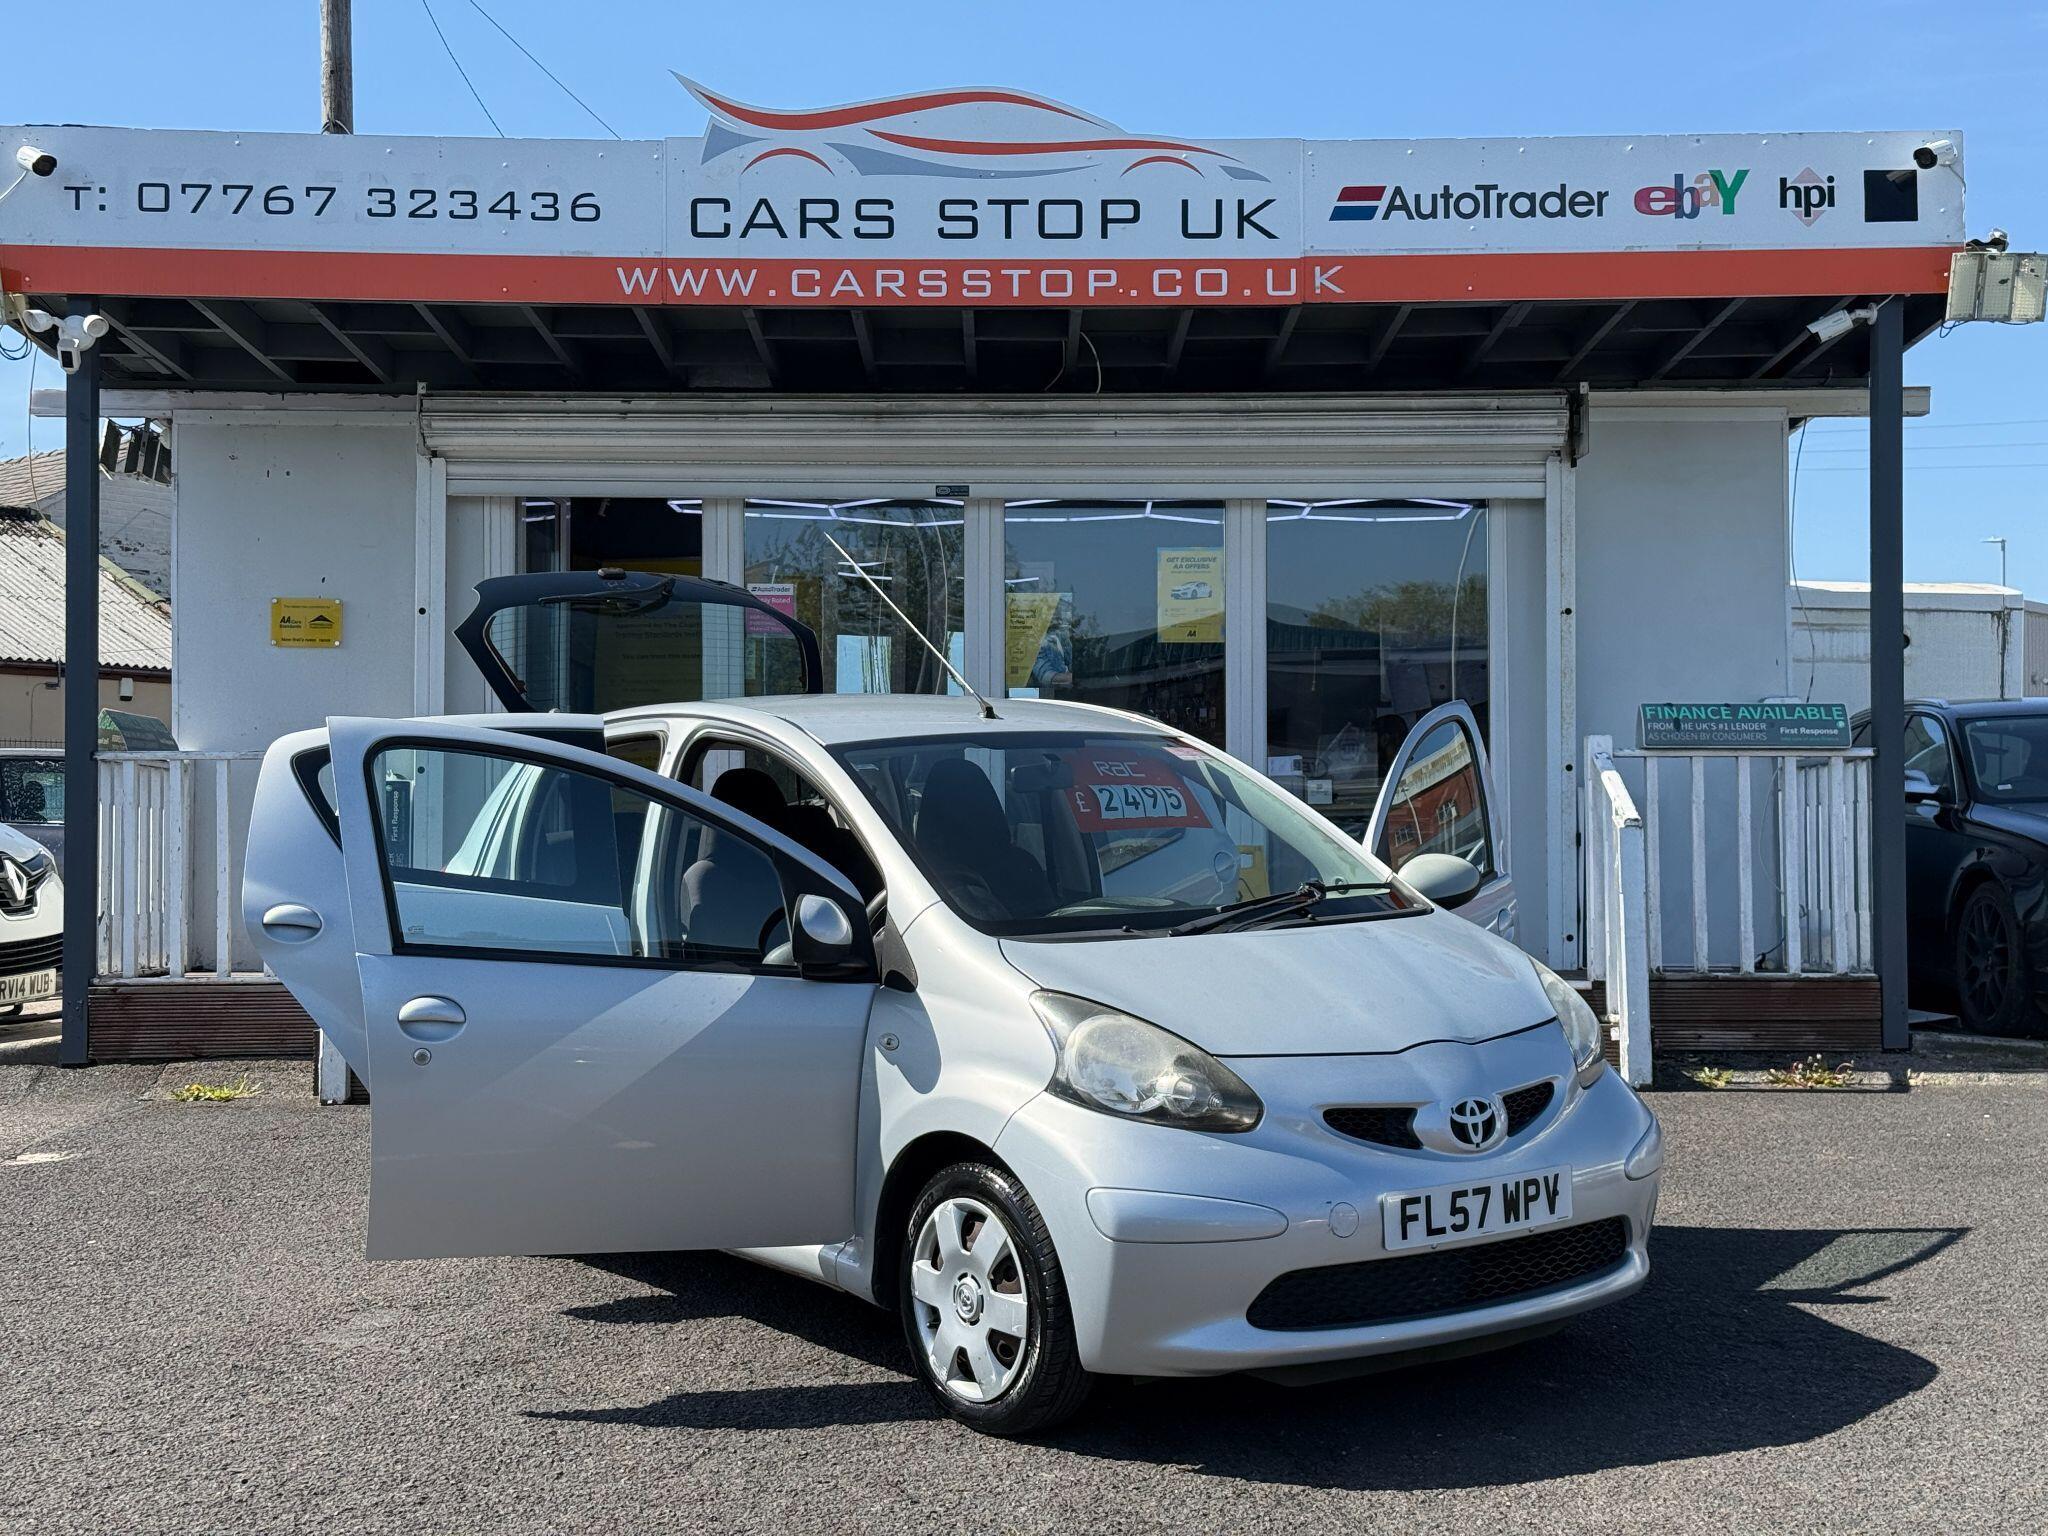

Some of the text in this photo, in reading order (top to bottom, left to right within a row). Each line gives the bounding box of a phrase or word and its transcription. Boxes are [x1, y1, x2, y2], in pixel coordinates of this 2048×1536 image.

[63, 182, 603, 223] T: 07767 323436
[1381, 182, 1610, 222] AutoTrader
[1779, 174, 1836, 218] hpi
[690, 197, 1281, 240] CARS STOP UK
[1186, 629, 1197, 638] AA
[1645, 706, 1845, 720] FINANCE AVAILABLE
[1647, 722, 1674, 731] FROM
[1674, 722, 1694, 731] HE
[1695, 722, 1718, 731] UK'S
[1730, 722, 1767, 731] LENDER
[1647, 731, 1660, 741] AS
[1660, 731, 1698, 741] CHOSEN
[1699, 731, 1711, 741] BY
[1711, 731, 1768, 741] CONSUMERS
[1779, 726, 1839, 736] First Response
[1399, 1172, 1560, 1241] FL57 WPV
